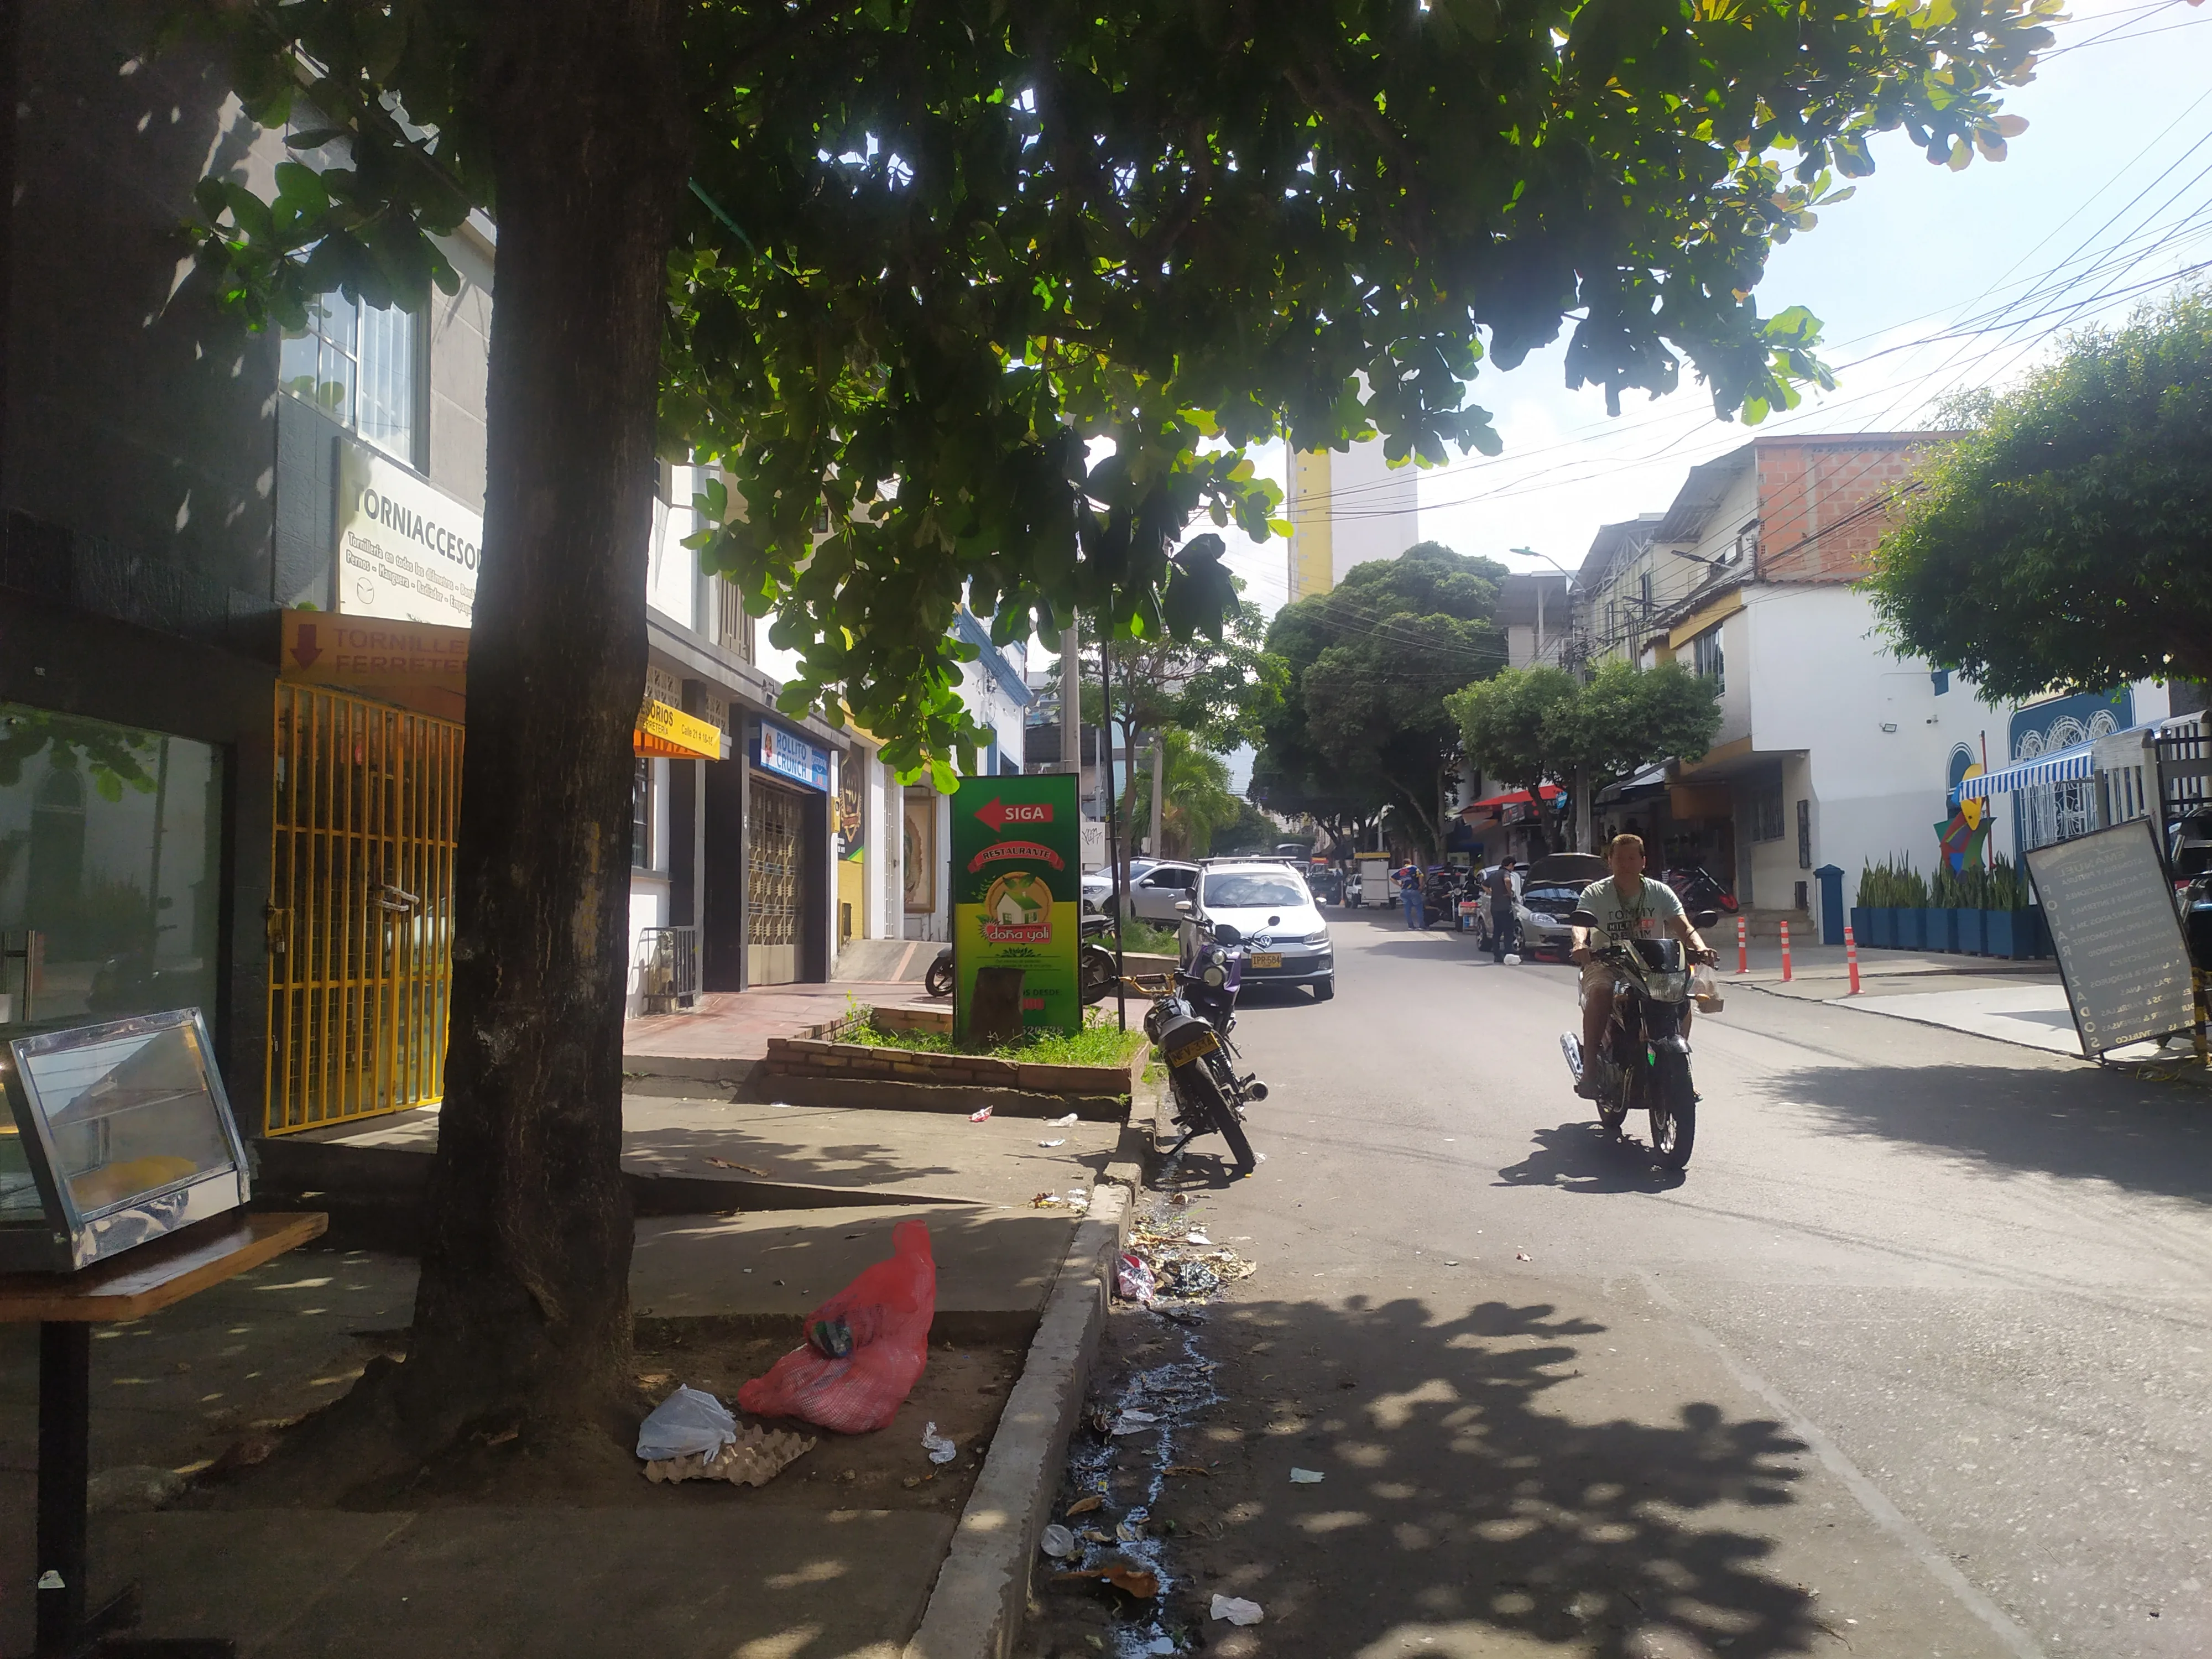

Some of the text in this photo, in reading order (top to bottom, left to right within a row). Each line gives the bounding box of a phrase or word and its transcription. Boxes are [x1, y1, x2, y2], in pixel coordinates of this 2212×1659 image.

[385, 552, 394, 564] en
[396, 555, 413, 572] todos
[415, 562, 424, 577] los
[346, 549, 370, 572] Pernos
[379, 564, 409, 588] Manguera
[417, 582, 443, 603] Radiador
[334, 628, 465, 654] TORNILLE
[681, 724, 692, 737] Calle
[693, 729, 698, 739] 21
[776, 732, 807, 760] ROLLITO
[776, 751, 807, 779] CRUNCH
[1004, 806, 1045, 821] SIGA
[982, 846, 1051, 860] RESTAURANTE
[989, 926, 1049, 942] doña yoli
[1611, 930, 1652, 941] DEIM
